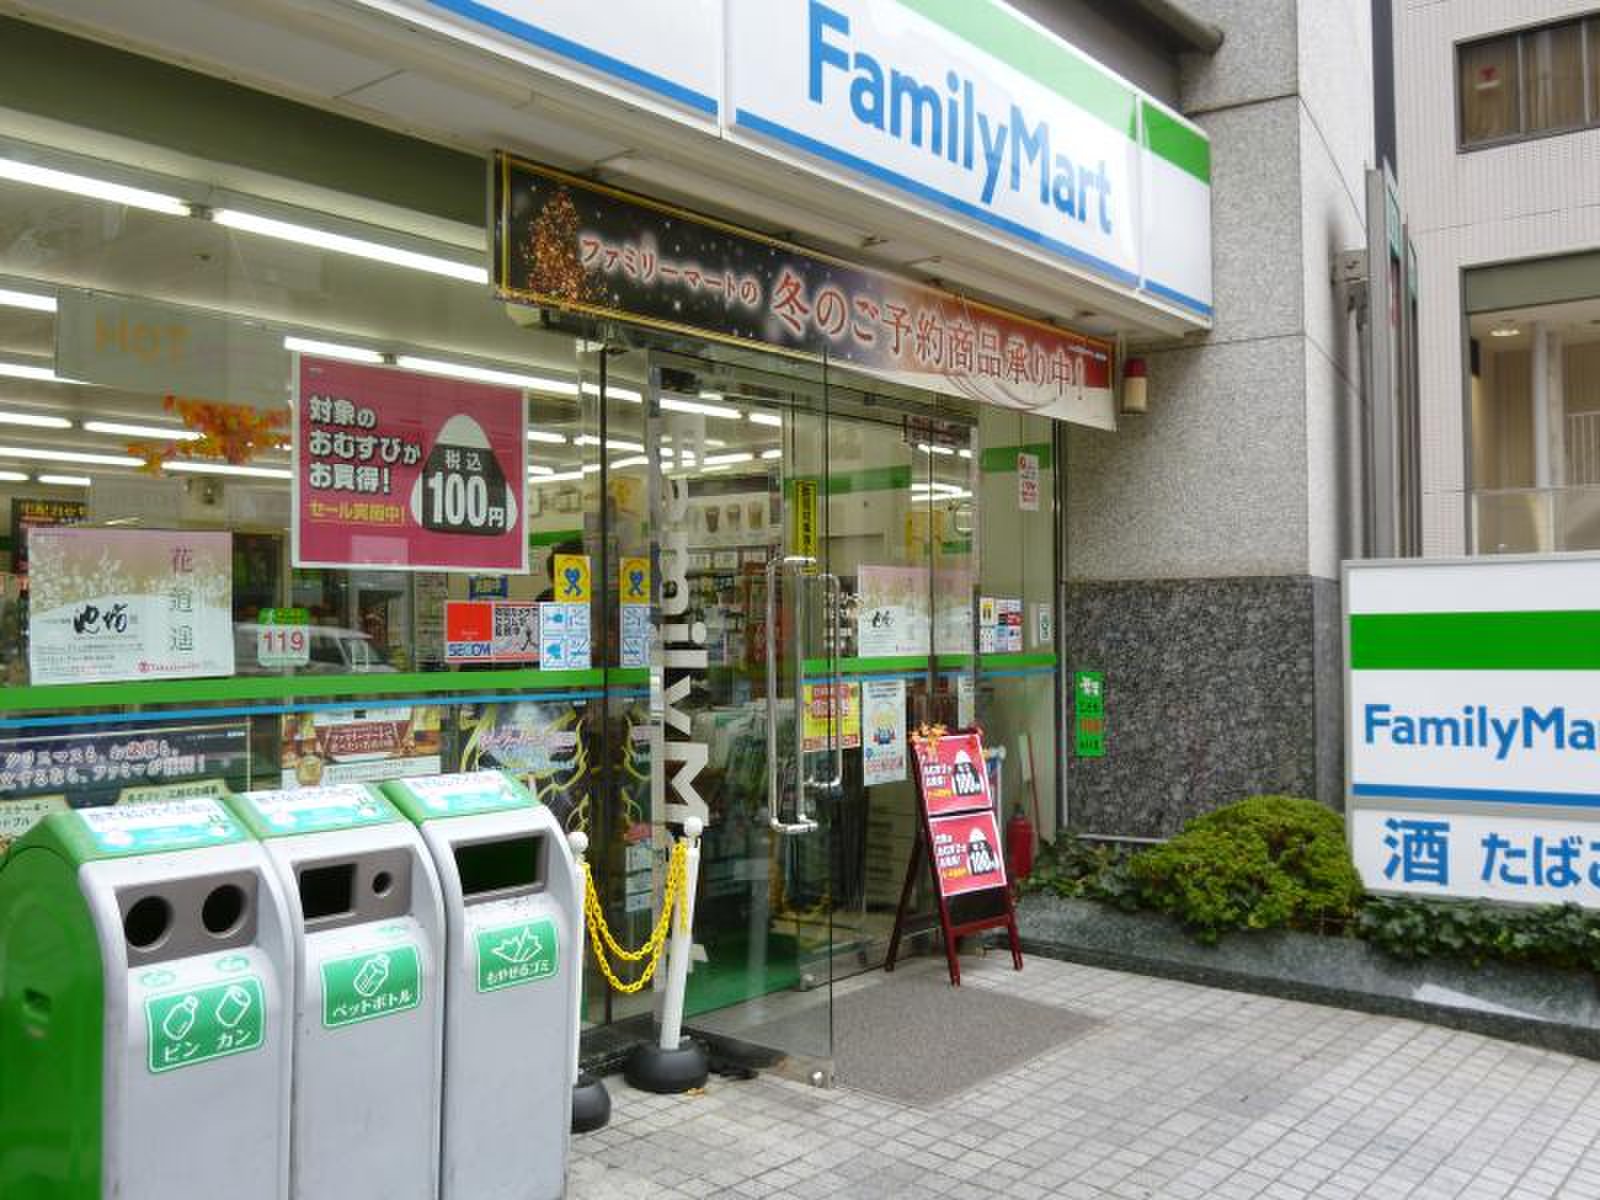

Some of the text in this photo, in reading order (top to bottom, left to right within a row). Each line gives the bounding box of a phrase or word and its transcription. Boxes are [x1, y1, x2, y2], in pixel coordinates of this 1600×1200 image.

[809, 0, 1111, 235] FamilyMart
[580, 237, 759, 306] ファミリーマートの
[308, 396, 377, 429] 対象の
[308, 430, 421, 466] おむすびが
[445, 449, 483, 472] 税込
[262, 631, 304, 653] 119
[447, 642, 492, 657] SECOM
[1364, 703, 1600, 760] FamilyMa
[1384, 817, 1451, 886] 酒
[331, 991, 414, 1018] ペットボトル
[217, 1028, 252, 1052] カン
